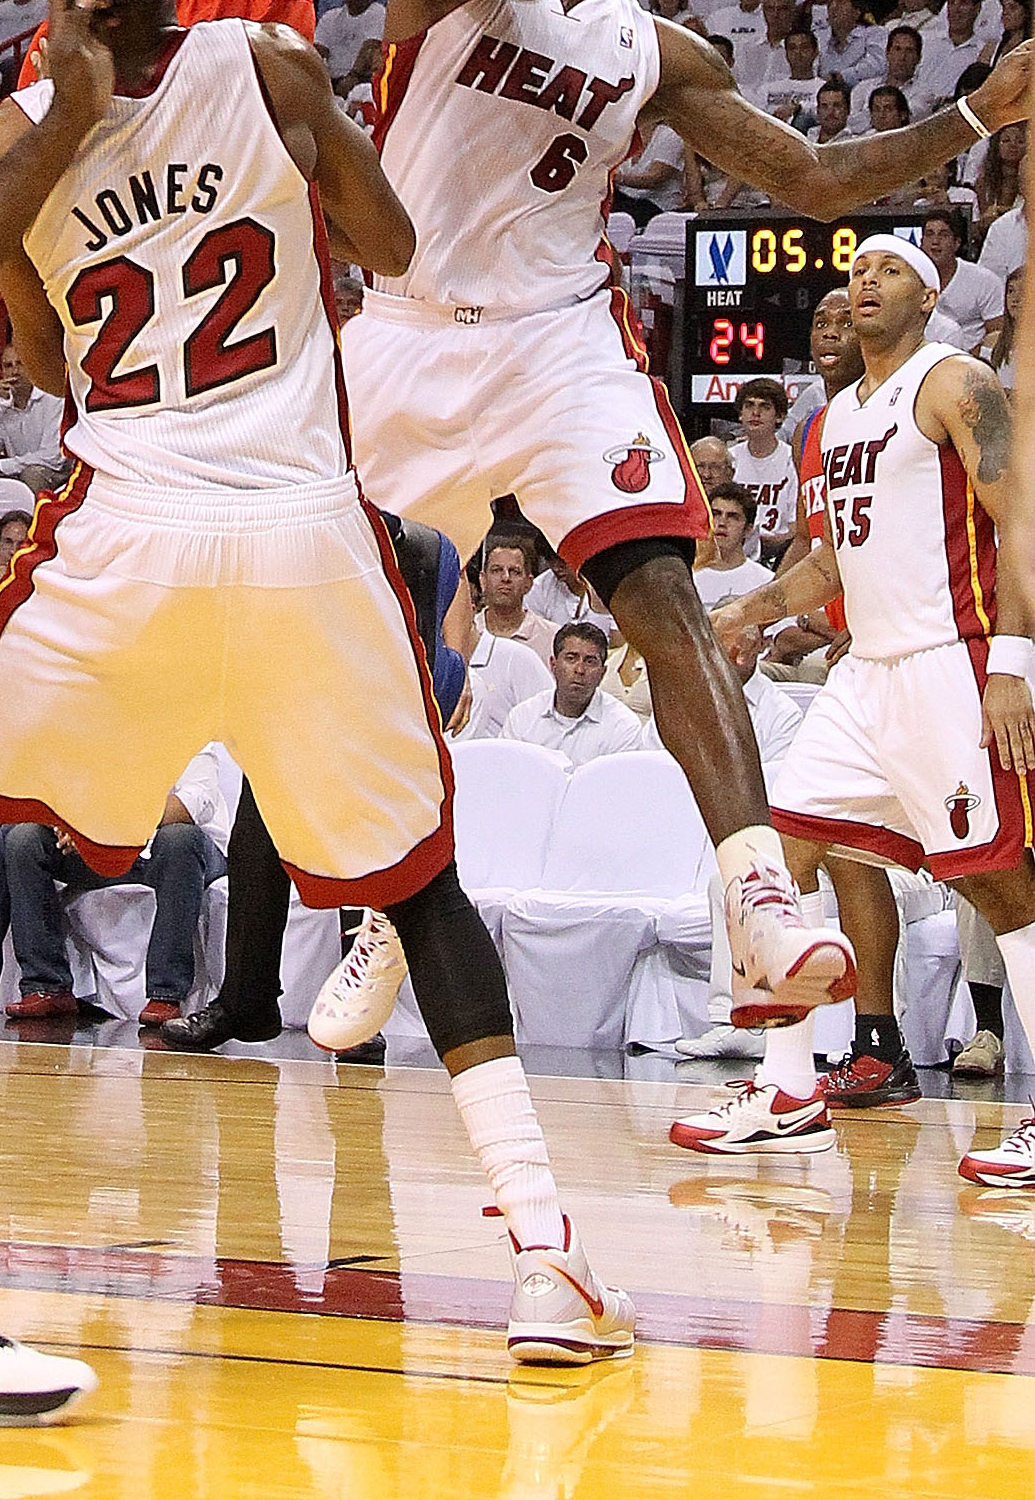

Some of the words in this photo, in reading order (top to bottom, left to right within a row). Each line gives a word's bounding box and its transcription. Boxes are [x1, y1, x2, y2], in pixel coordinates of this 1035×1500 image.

[454, 33, 637, 133] HEAT
[529, 131, 590, 194] 6
[71, 162, 224, 252] JONES
[752, 228, 857, 273] 05.8
[65, 216, 279, 414] 22
[706, 290, 743, 307] HEAT
[709, 318, 764, 365] 24
[741, 477, 789, 506] EAT
[762, 508, 778, 531] 3
[832, 496, 873, 551] 55
